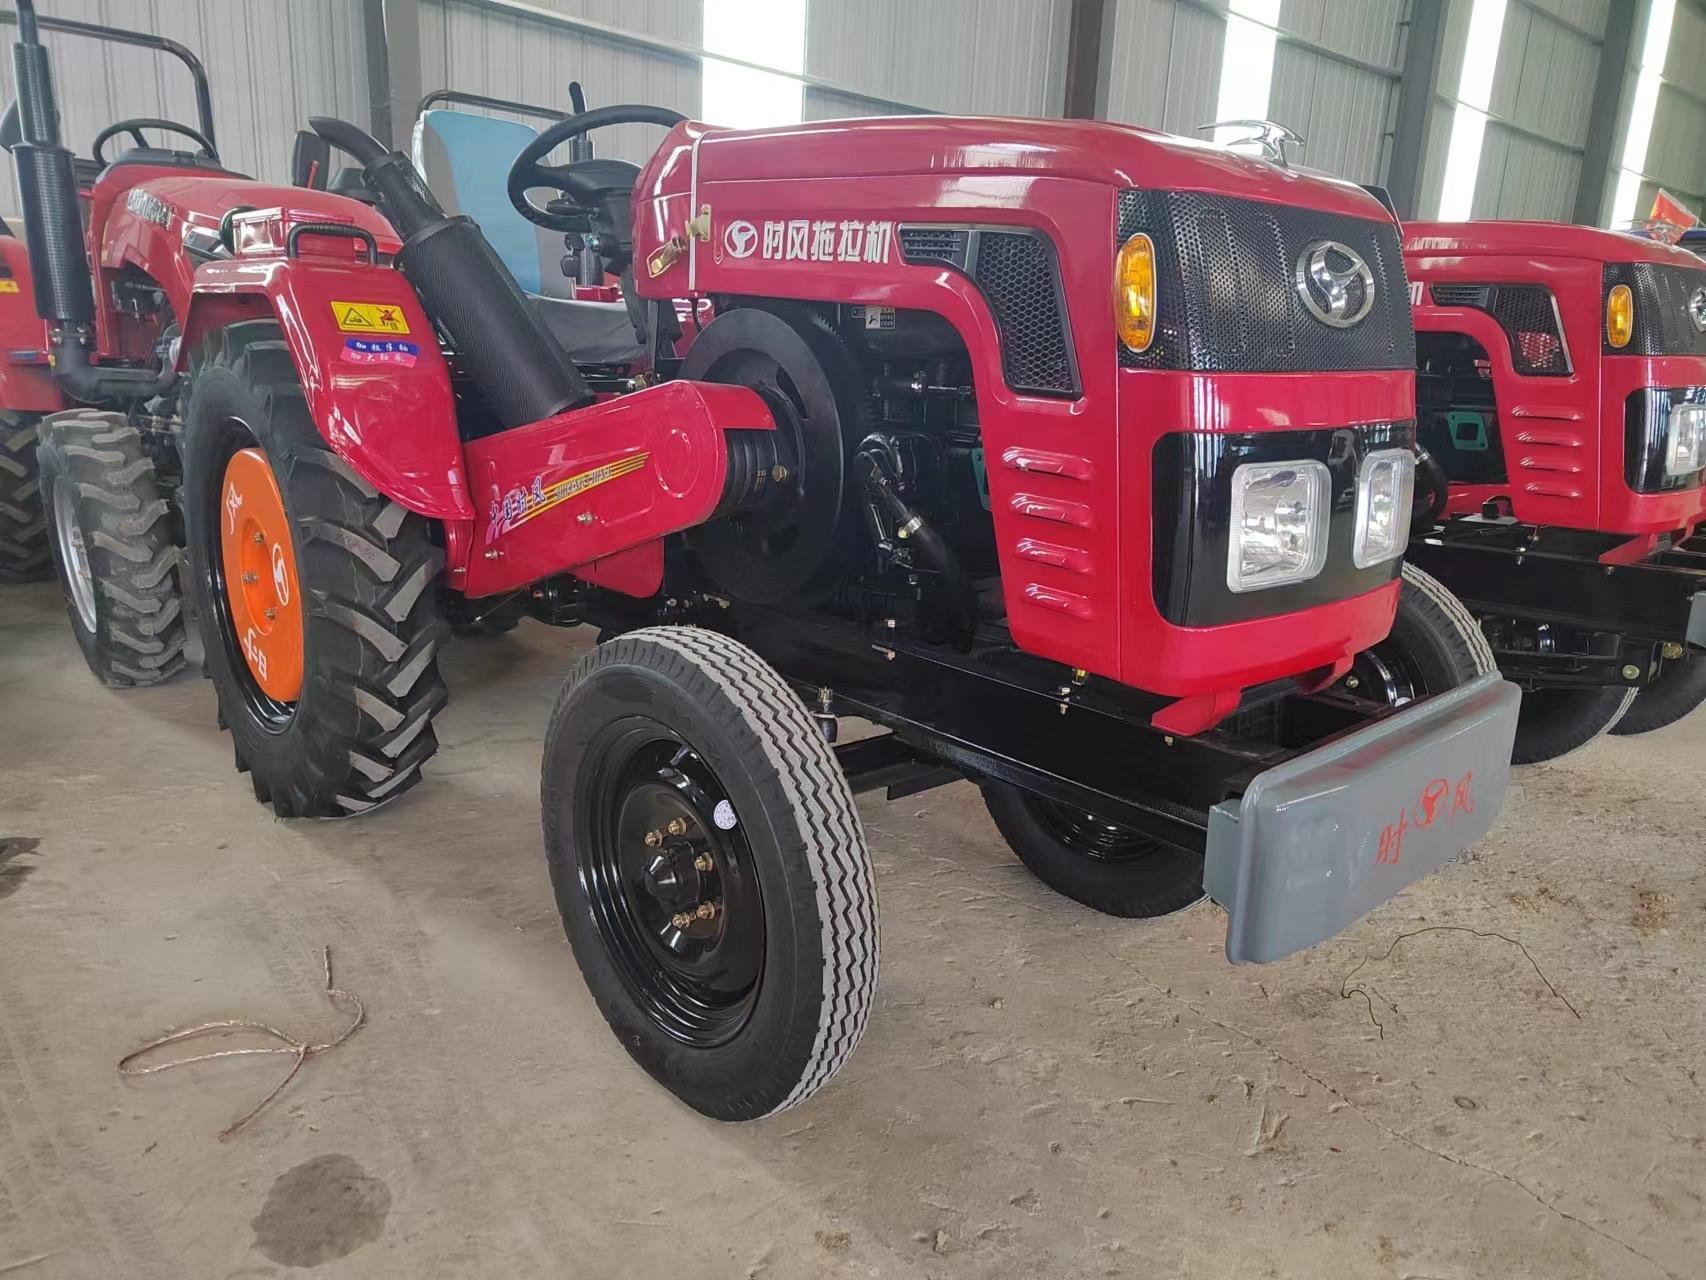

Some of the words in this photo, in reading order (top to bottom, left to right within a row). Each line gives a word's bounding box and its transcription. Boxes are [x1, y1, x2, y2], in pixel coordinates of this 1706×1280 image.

[762, 219, 893, 264] 时风拖拉机
